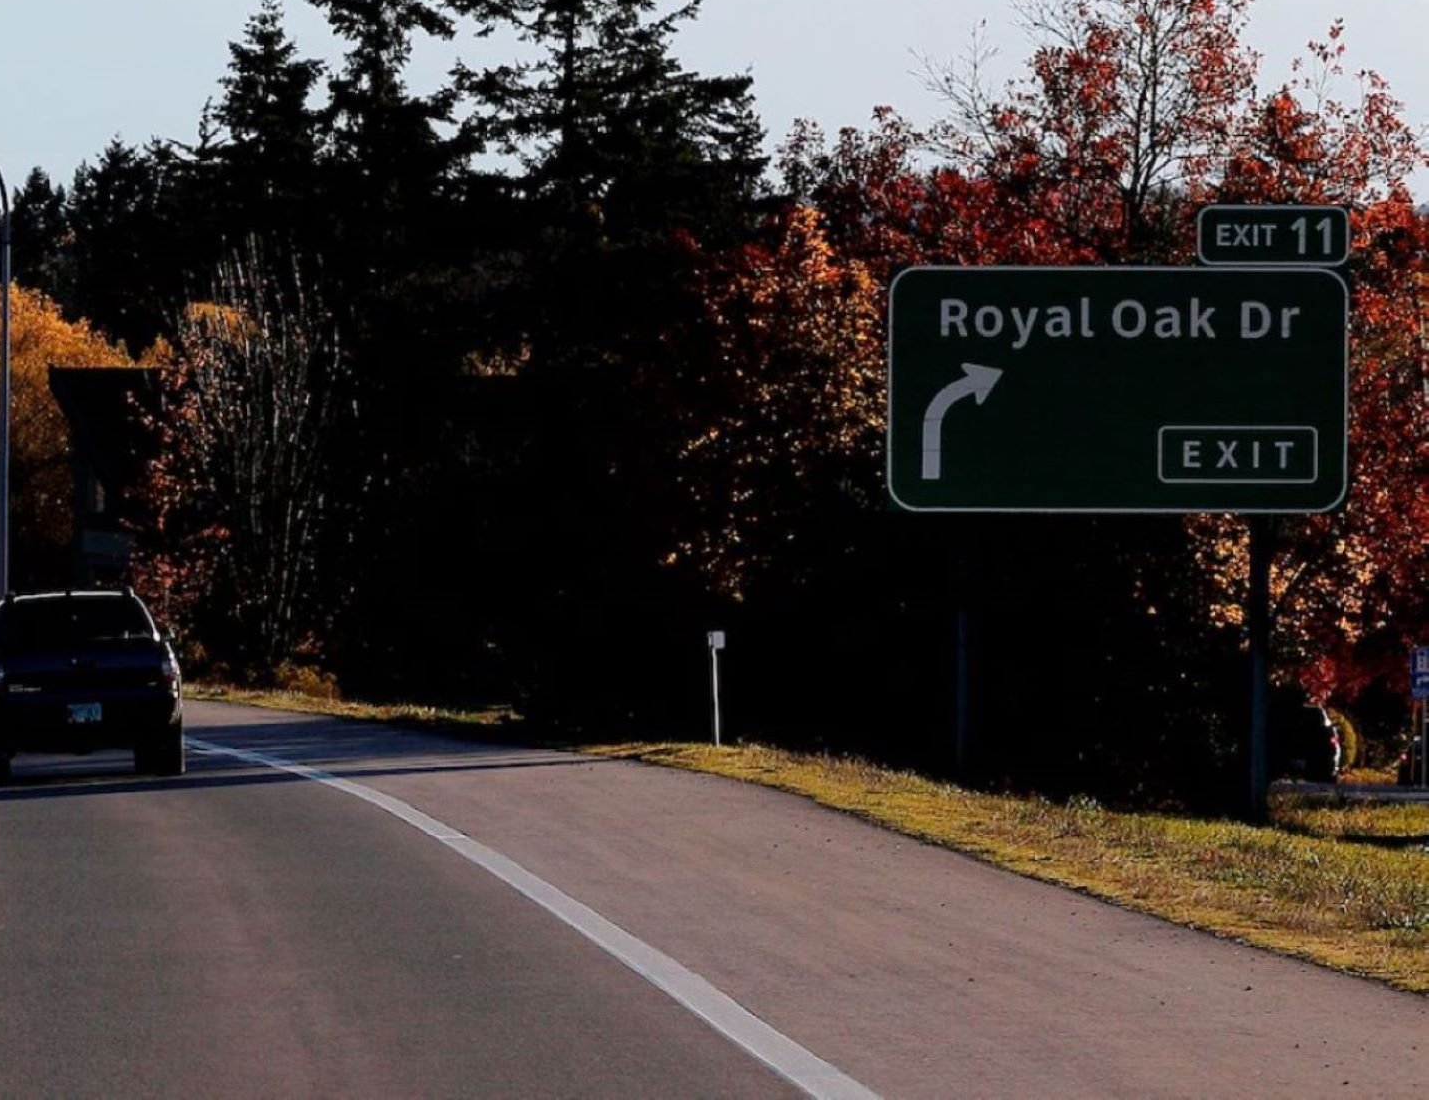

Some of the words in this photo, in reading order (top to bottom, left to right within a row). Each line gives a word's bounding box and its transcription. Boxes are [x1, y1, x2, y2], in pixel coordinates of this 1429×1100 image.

[1216, 224, 1277, 247] EXIT
[1290, 217, 1333, 254] 11
[940, 297, 1094, 349] Royal
[1112, 297, 1216, 339] Oak
[1241, 301, 1300, 339] Dr
[1183, 440, 1294, 469] EXIT
